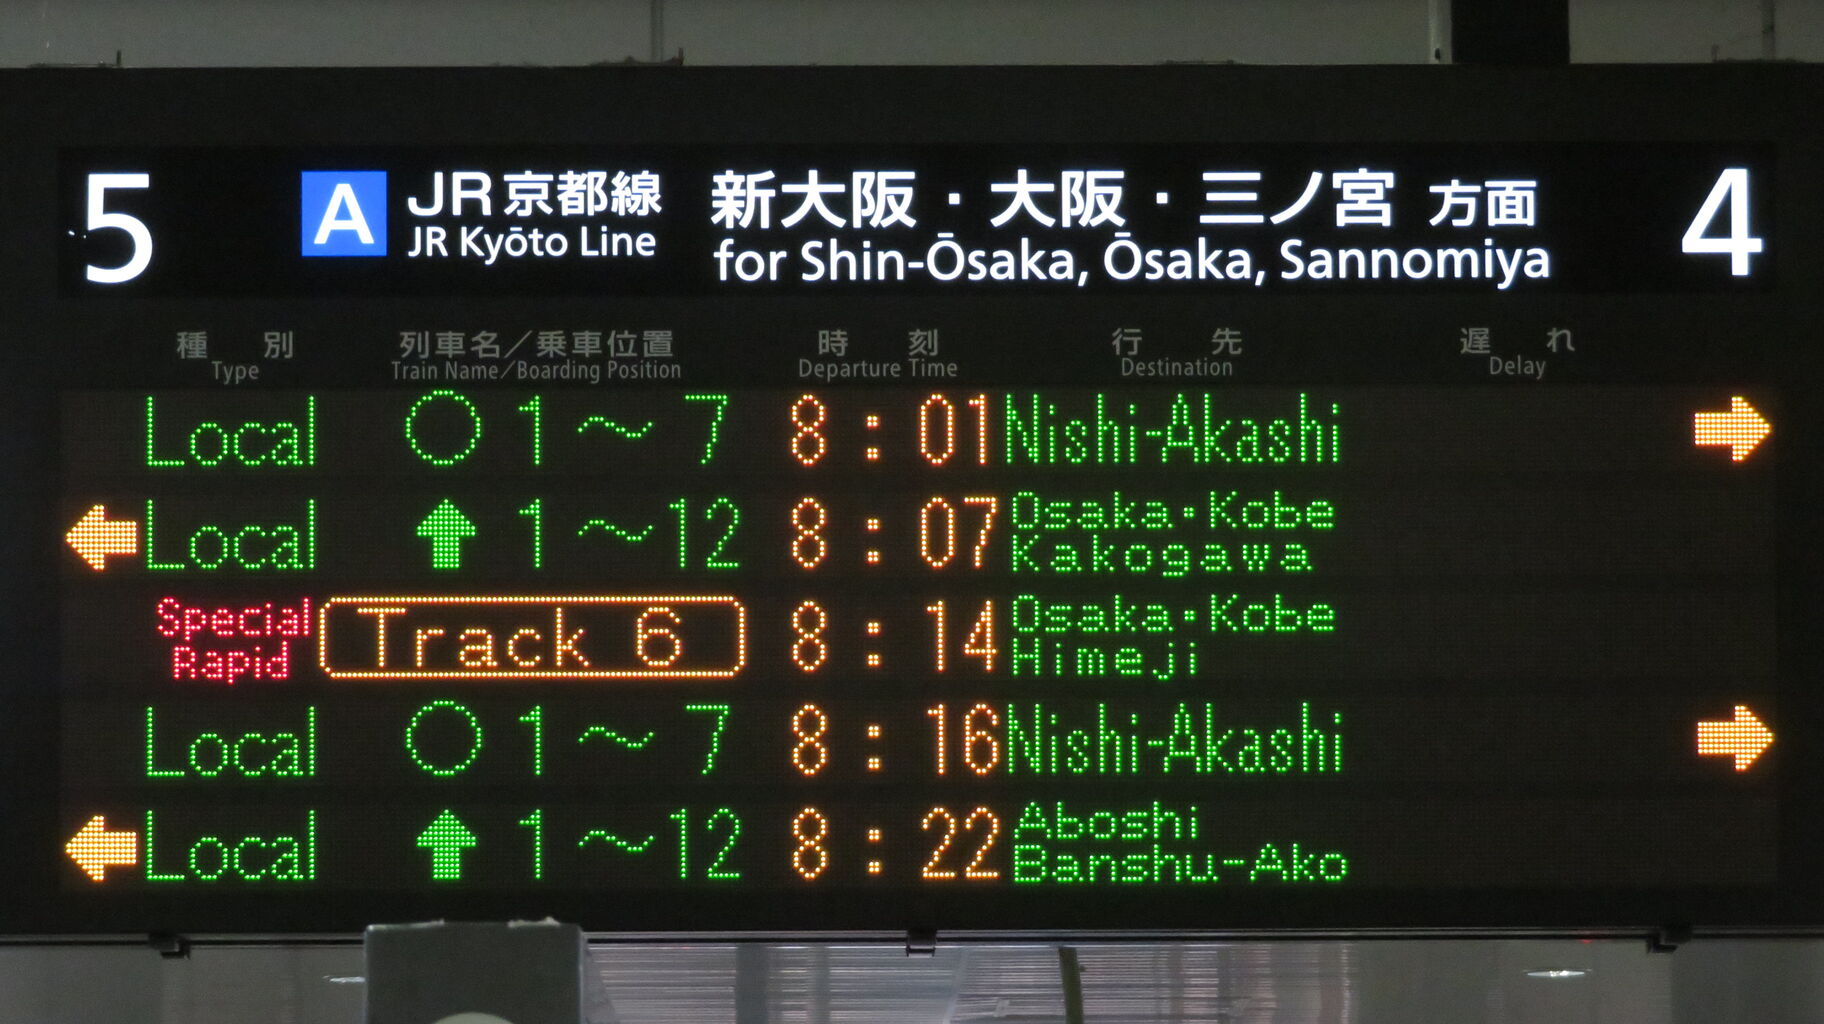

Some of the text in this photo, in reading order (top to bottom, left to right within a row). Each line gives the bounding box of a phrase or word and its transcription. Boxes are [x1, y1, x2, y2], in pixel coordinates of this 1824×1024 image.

[314, 184, 374, 244] A
[1429, 179, 1537, 227] 方面
[1682, 167, 1764, 276] 4
[84, 173, 152, 284] 5
[408, 225, 656, 265] JR Kyōto Line
[713, 232, 1550, 290] for Shin-Ōsaka, Ōsaka, Sannomiya
[212, 361, 260, 384] Type
[392, 361, 438, 380] Train
[609, 361, 680, 378] Position
[799, 359, 958, 381] Departure Time
[1120, 358, 1233, 377] Destination
[1489, 357, 1546, 380] Delay
[147, 396, 314, 466] Local
[1007, 393, 1338, 463] Nishi-Akashi
[147, 499, 314, 569] Local
[1013, 534, 1312, 576] Kakogawa
[156, 597, 311, 639] Special
[357, 606, 683, 668] Track 6
[172, 643, 290, 684] Rapid
[1013, 638, 1196, 680] Himeji
[147, 707, 314, 776] Local
[1008, 702, 1341, 773] Nishi-Akashi
[1014, 801, 1197, 839] Aboshi
[147, 810, 314, 880] Local
[1014, 844, 1347, 882] Banshu-Ako
